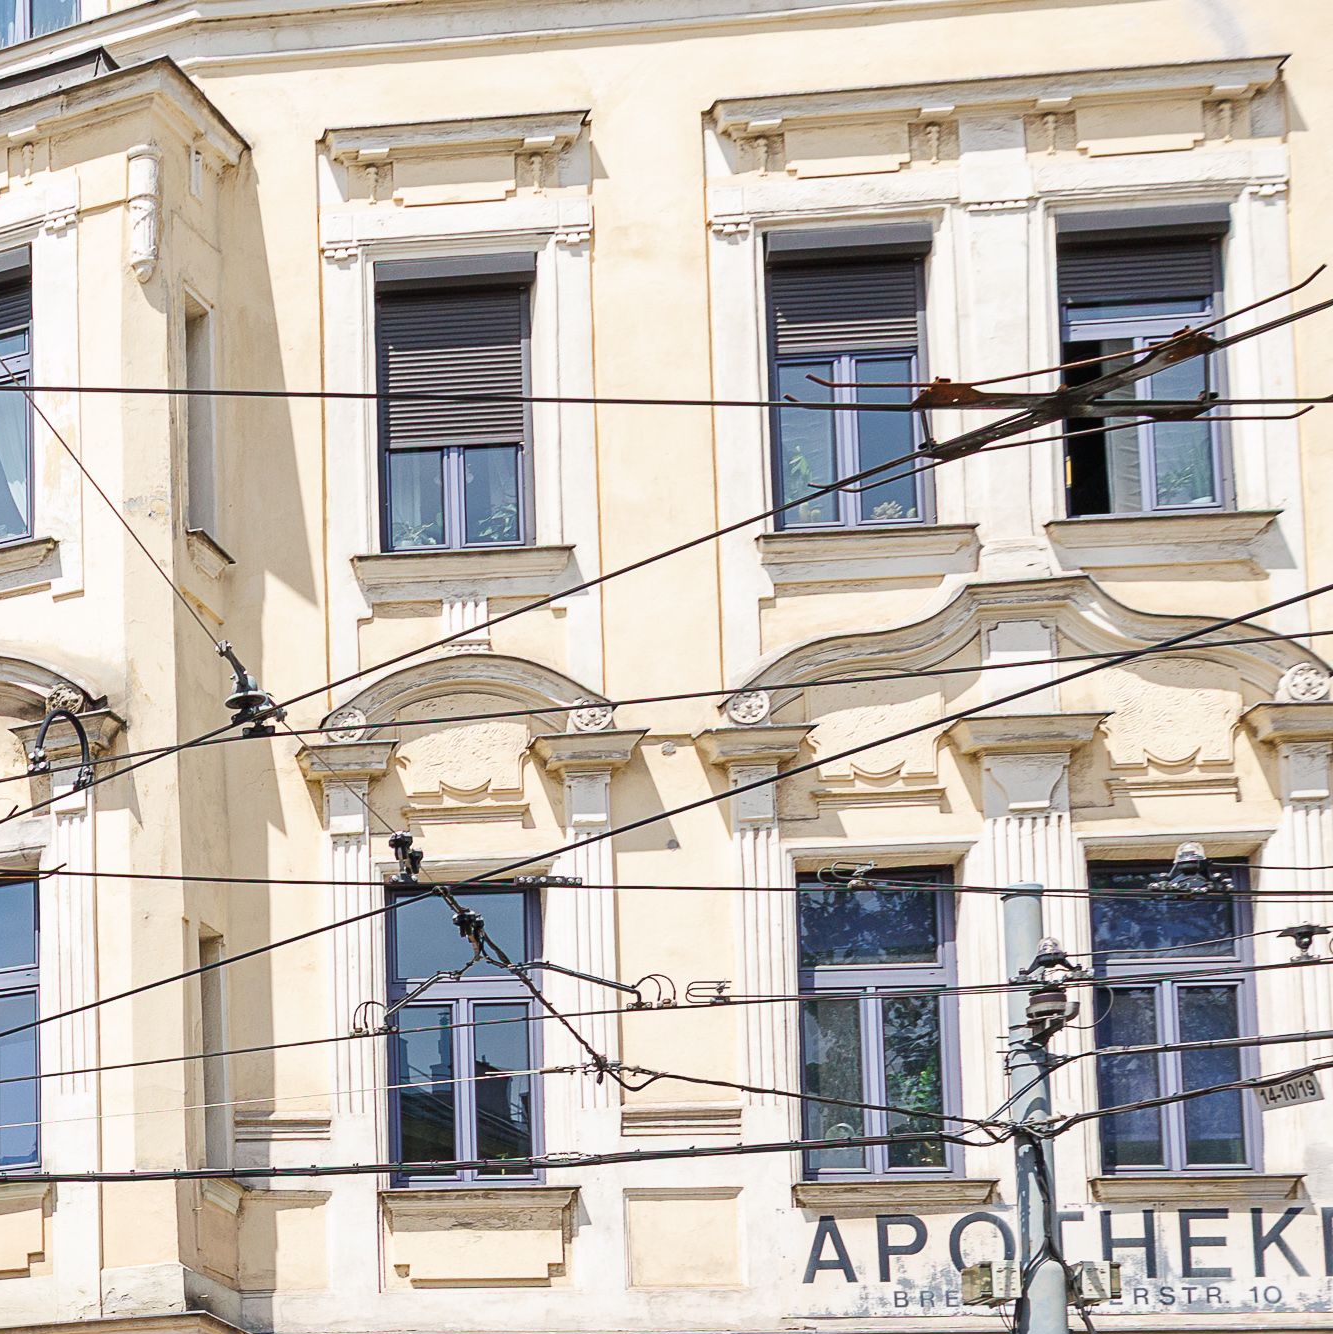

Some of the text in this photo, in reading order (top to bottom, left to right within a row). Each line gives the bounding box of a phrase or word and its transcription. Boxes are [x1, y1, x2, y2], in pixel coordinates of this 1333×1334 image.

[1260, 1079, 1316, 1105] 14-10/19
[802, 1206, 1333, 1284] APOTHEK
[1249, 1285, 1283, 1305] 10
